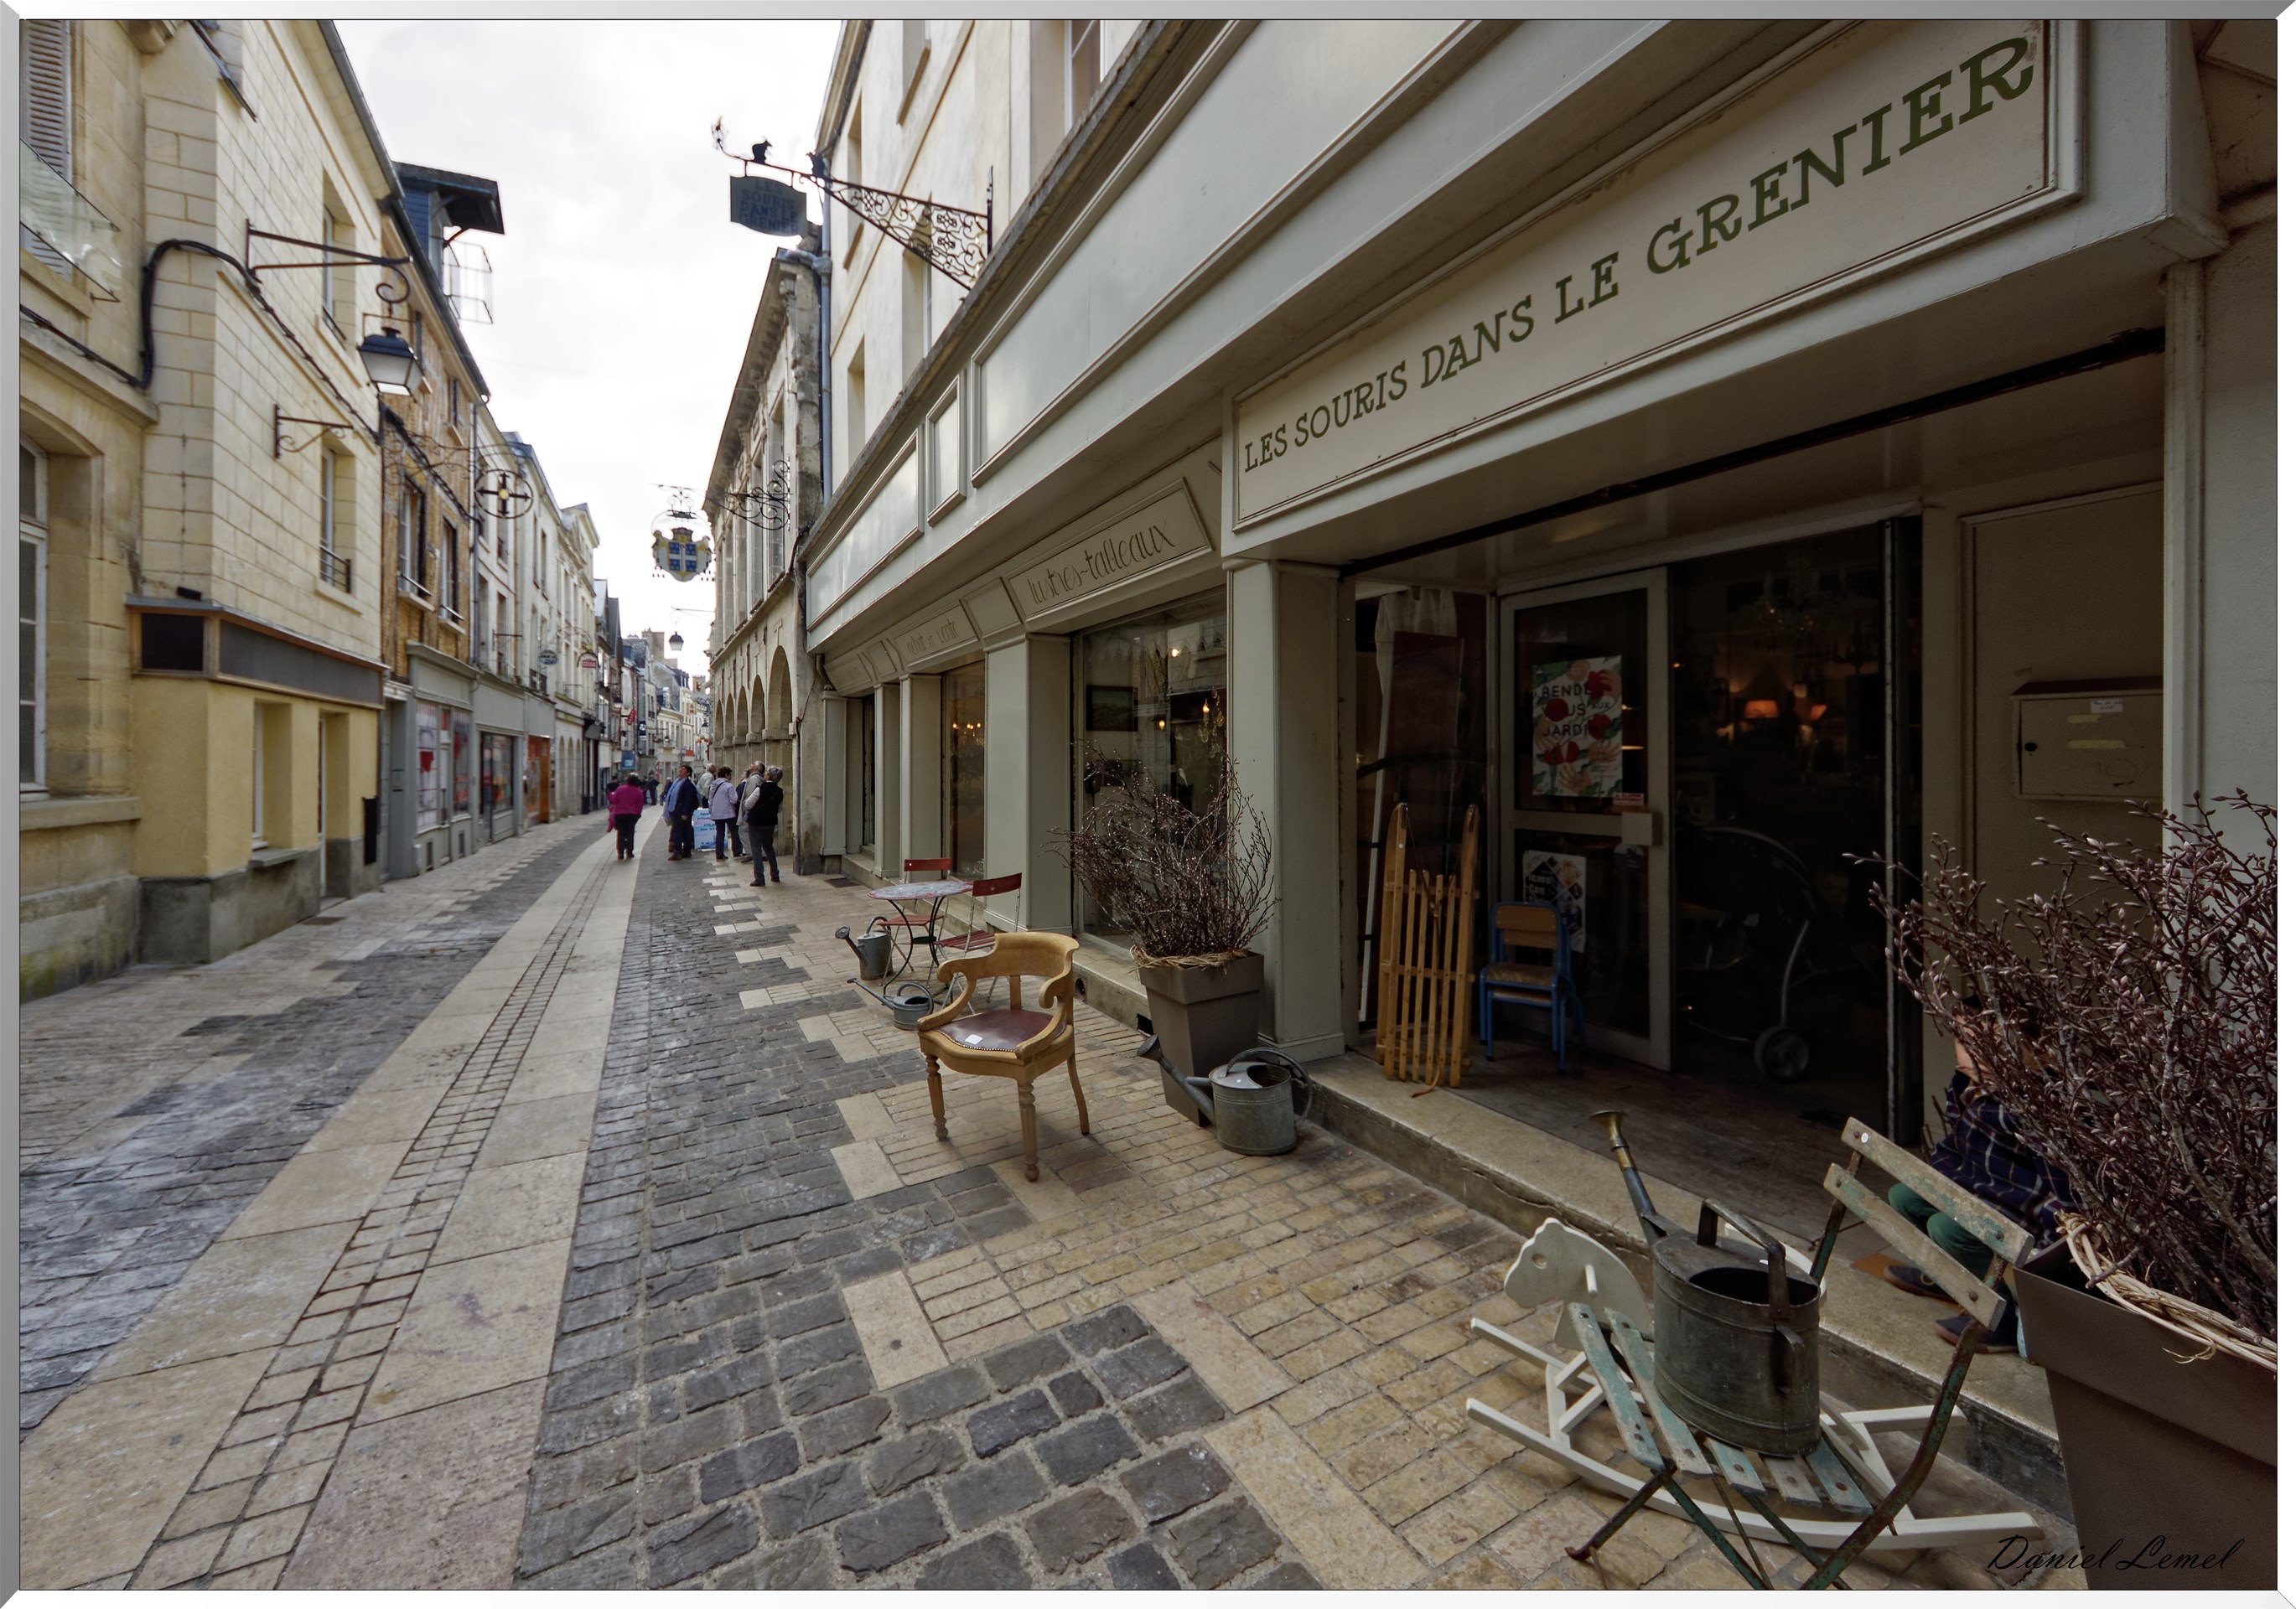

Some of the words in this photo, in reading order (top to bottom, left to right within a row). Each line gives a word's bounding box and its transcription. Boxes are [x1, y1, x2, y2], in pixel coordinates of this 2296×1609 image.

[741, 189, 795, 210] SOURIS
[1244, 424, 1288, 472] LES
[1293, 361, 1407, 448] SOURIS
[1421, 296, 1533, 390] DANS
[1554, 251, 1620, 325] LE
[1647, 37, 2034, 274] GRENIER
